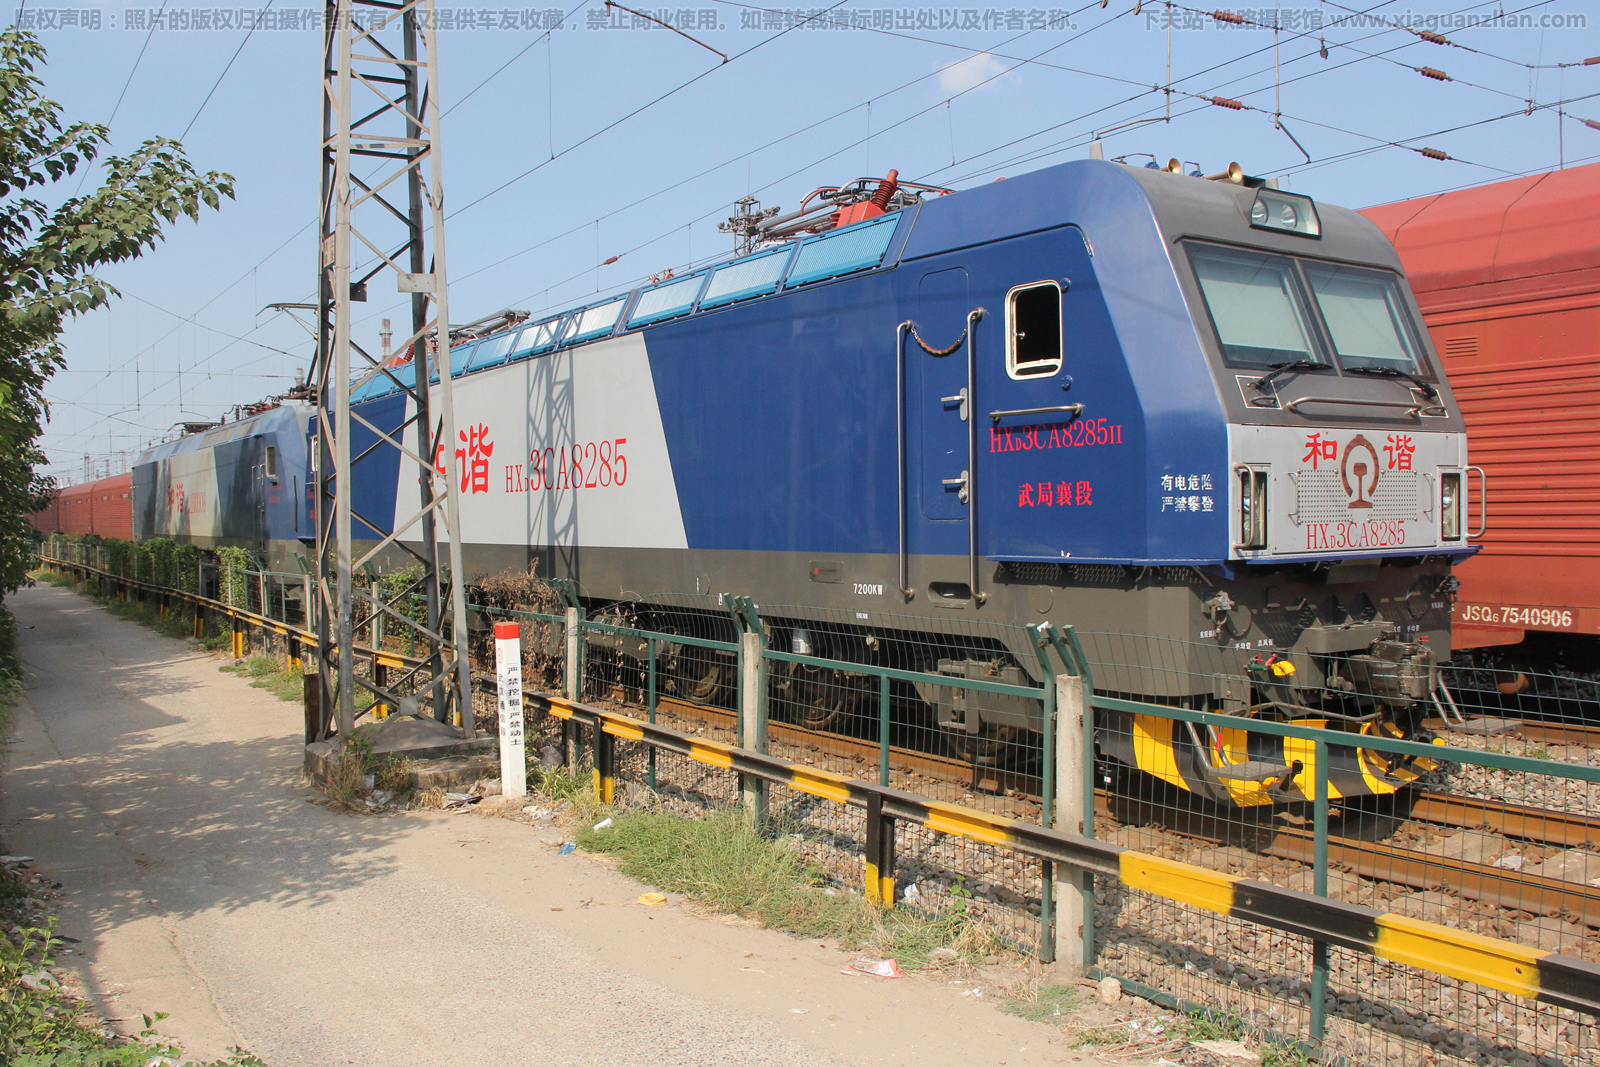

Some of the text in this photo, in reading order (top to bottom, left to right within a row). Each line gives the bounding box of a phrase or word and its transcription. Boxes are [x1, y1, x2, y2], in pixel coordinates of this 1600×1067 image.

[1161, 473, 1214, 491] 有电危险
[1017, 480, 1093, 508] 武局襄段
[1161, 496, 1214, 512] 严禁攀登
[1306, 520, 1406, 550] HXD3CA8285
[853, 583, 883, 596] 7200KW
[1462, 605, 1573, 627] JSQ6 7540906
